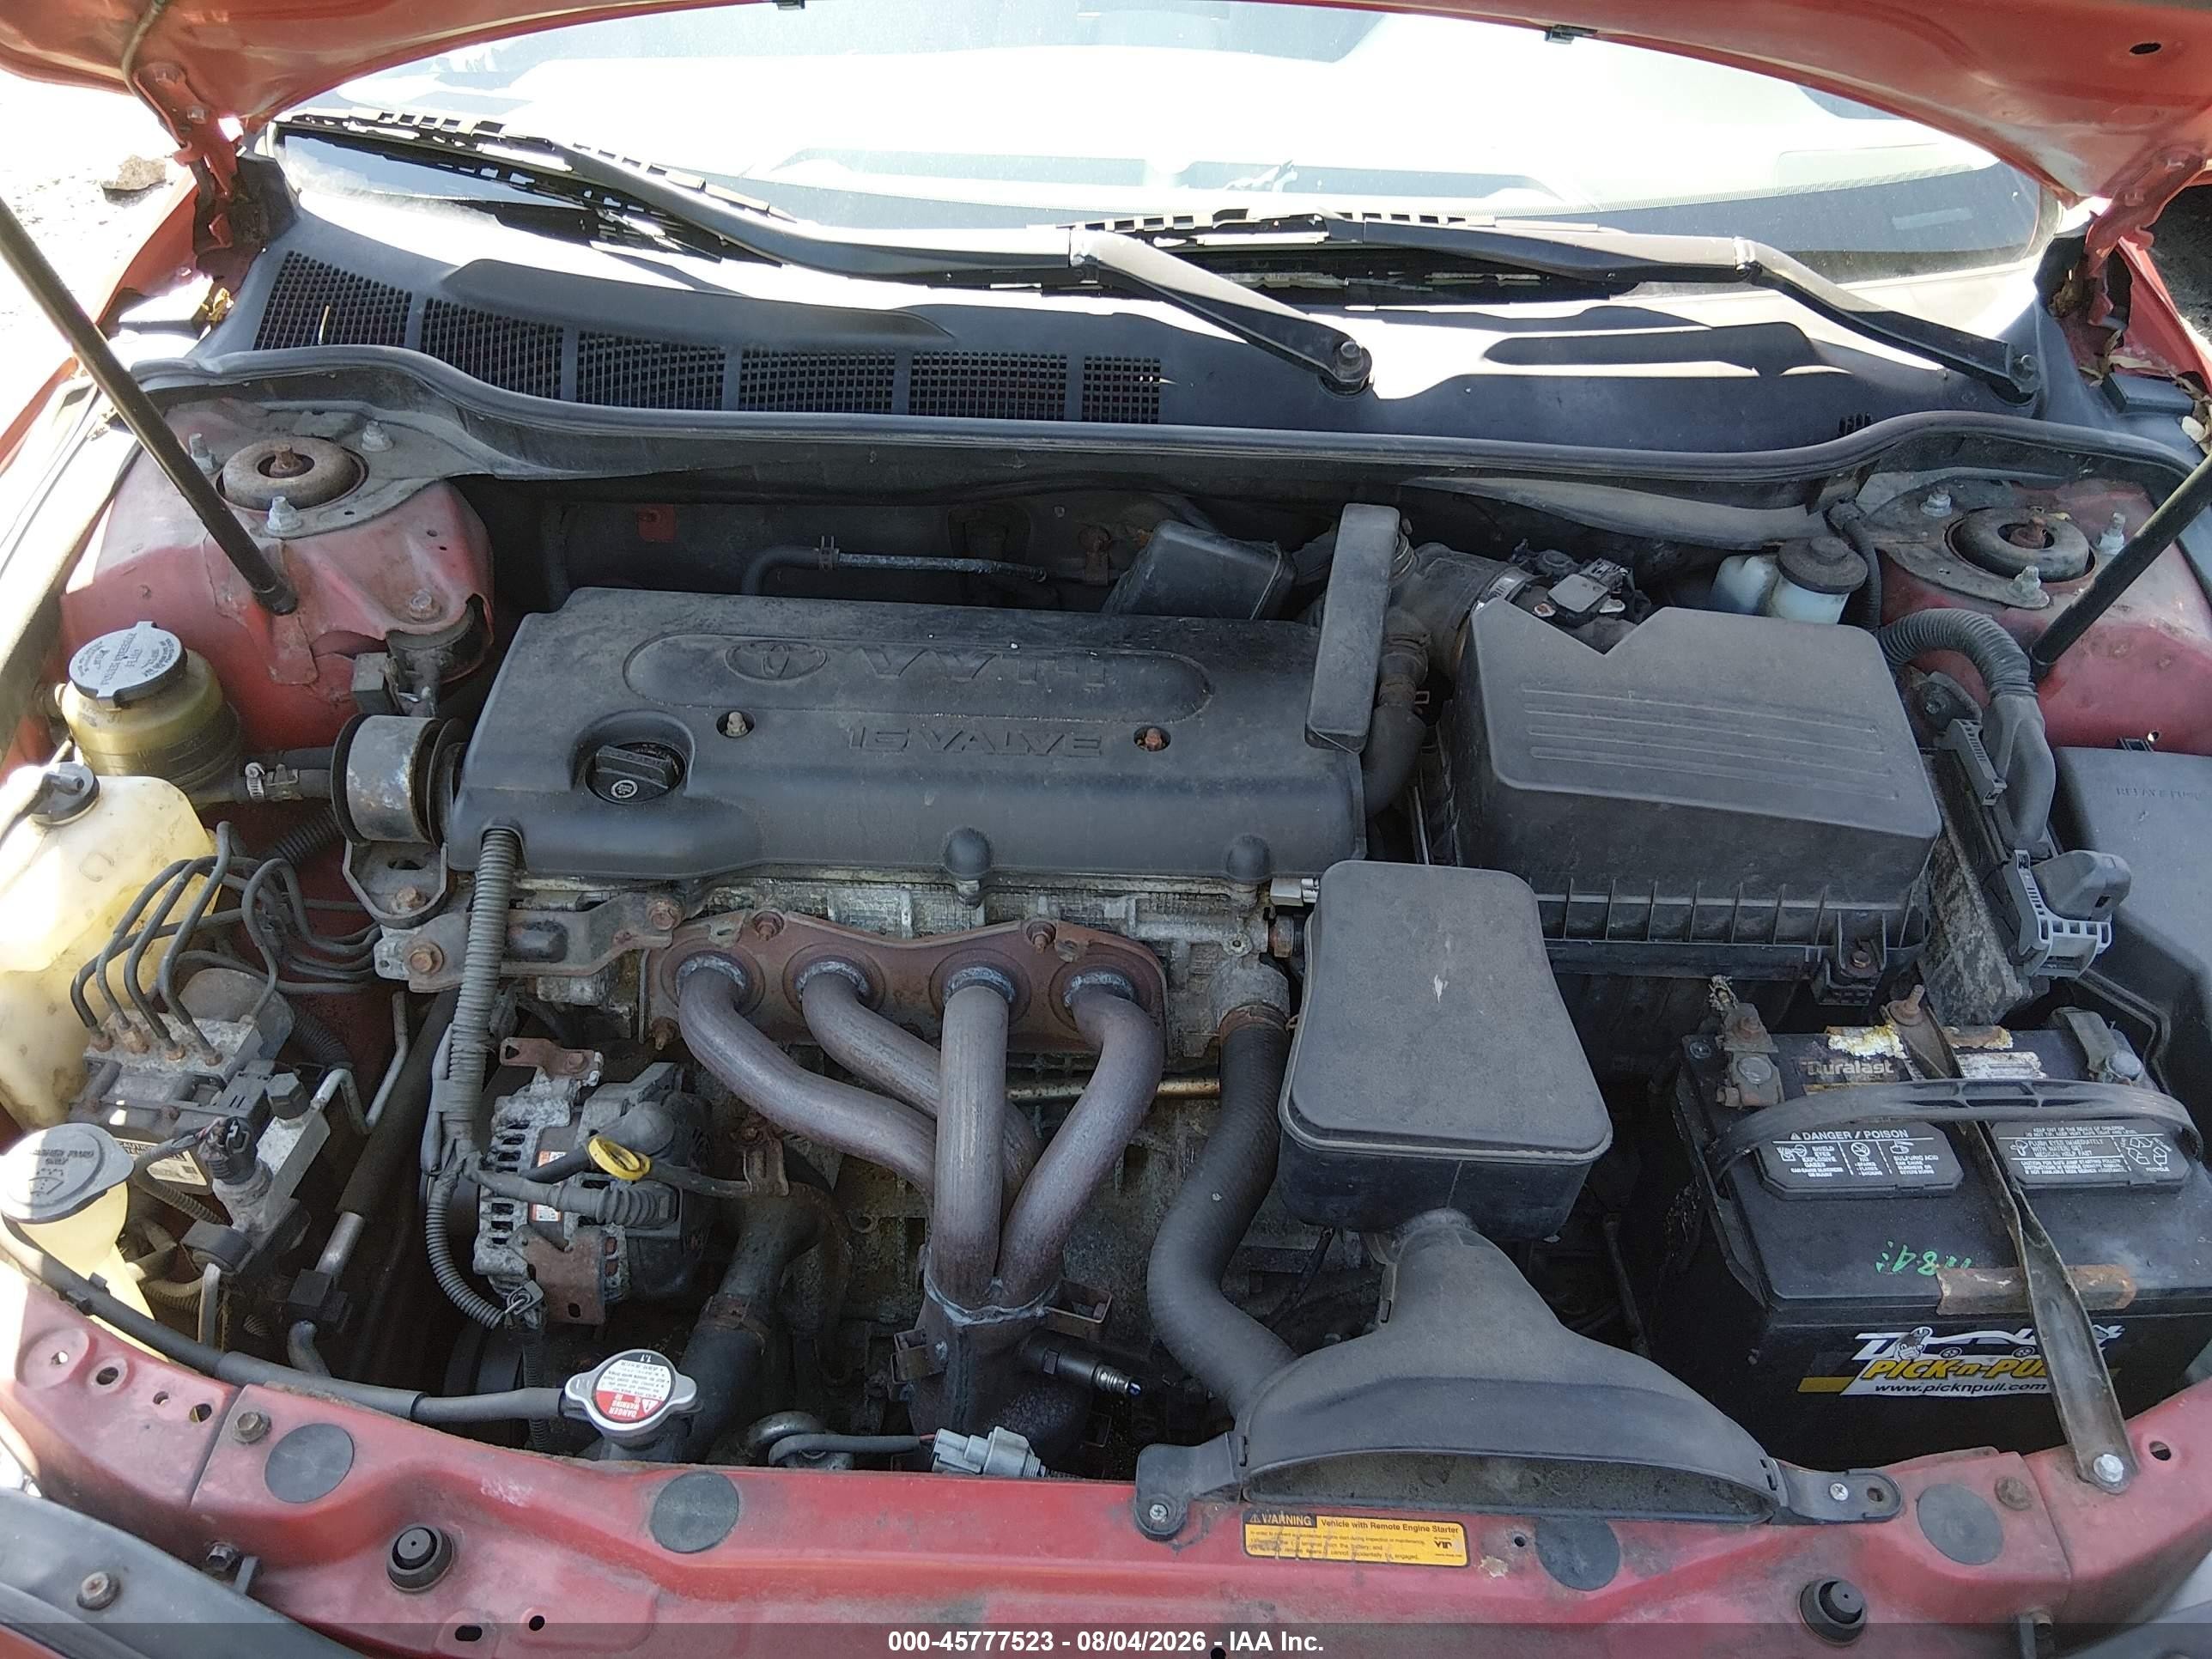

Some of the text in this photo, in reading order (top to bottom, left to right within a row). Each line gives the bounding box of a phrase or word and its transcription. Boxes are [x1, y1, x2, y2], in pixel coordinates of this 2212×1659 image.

[1802, 1057, 1894, 1075] Duralast
[1802, 1131, 1852, 1141] DANGER
[1864, 1129, 1909, 1139] POISON
[1862, 1358, 2047, 1380] PICK-n-PU
[1875, 1382, 2047, 1395] www.picknpull.com
[611, 1400, 640, 1410] WARNING
[608, 1407, 637, 1418] DANGER
[1261, 1512, 1459, 1534] WARNING Vehicle with Remote Engine Starter
